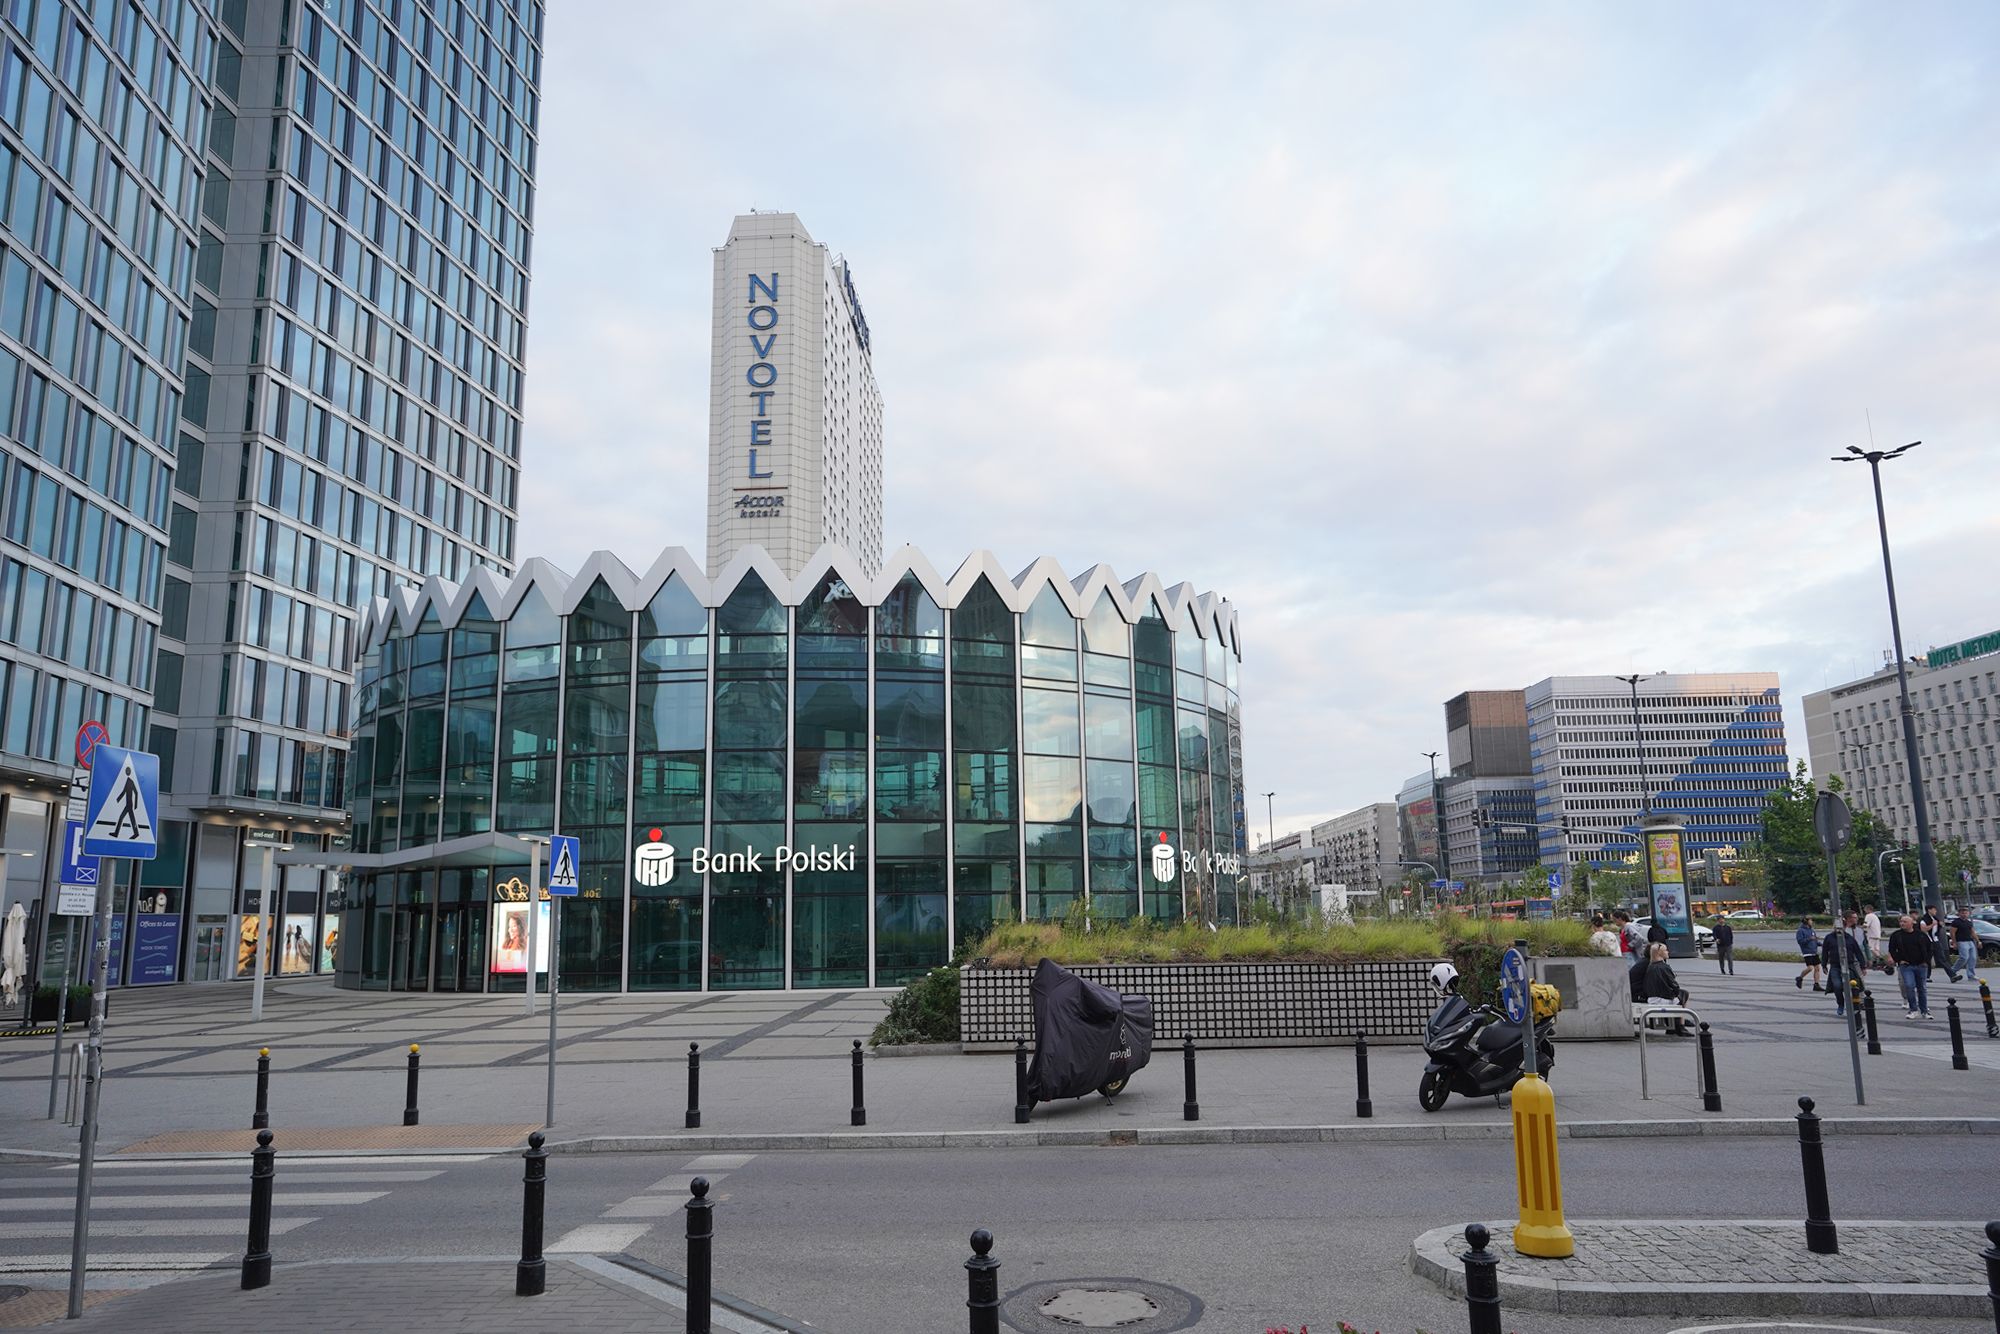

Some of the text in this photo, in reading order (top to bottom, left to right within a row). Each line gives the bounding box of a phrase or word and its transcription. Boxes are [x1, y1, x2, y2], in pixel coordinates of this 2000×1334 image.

[747, 273, 778, 479] NOVOTEL
[740, 508, 780, 518] hotels
[1927, 645, 1961, 668] HOTEL
[692, 845, 762, 874] Bank
[775, 843, 855, 872] Polski
